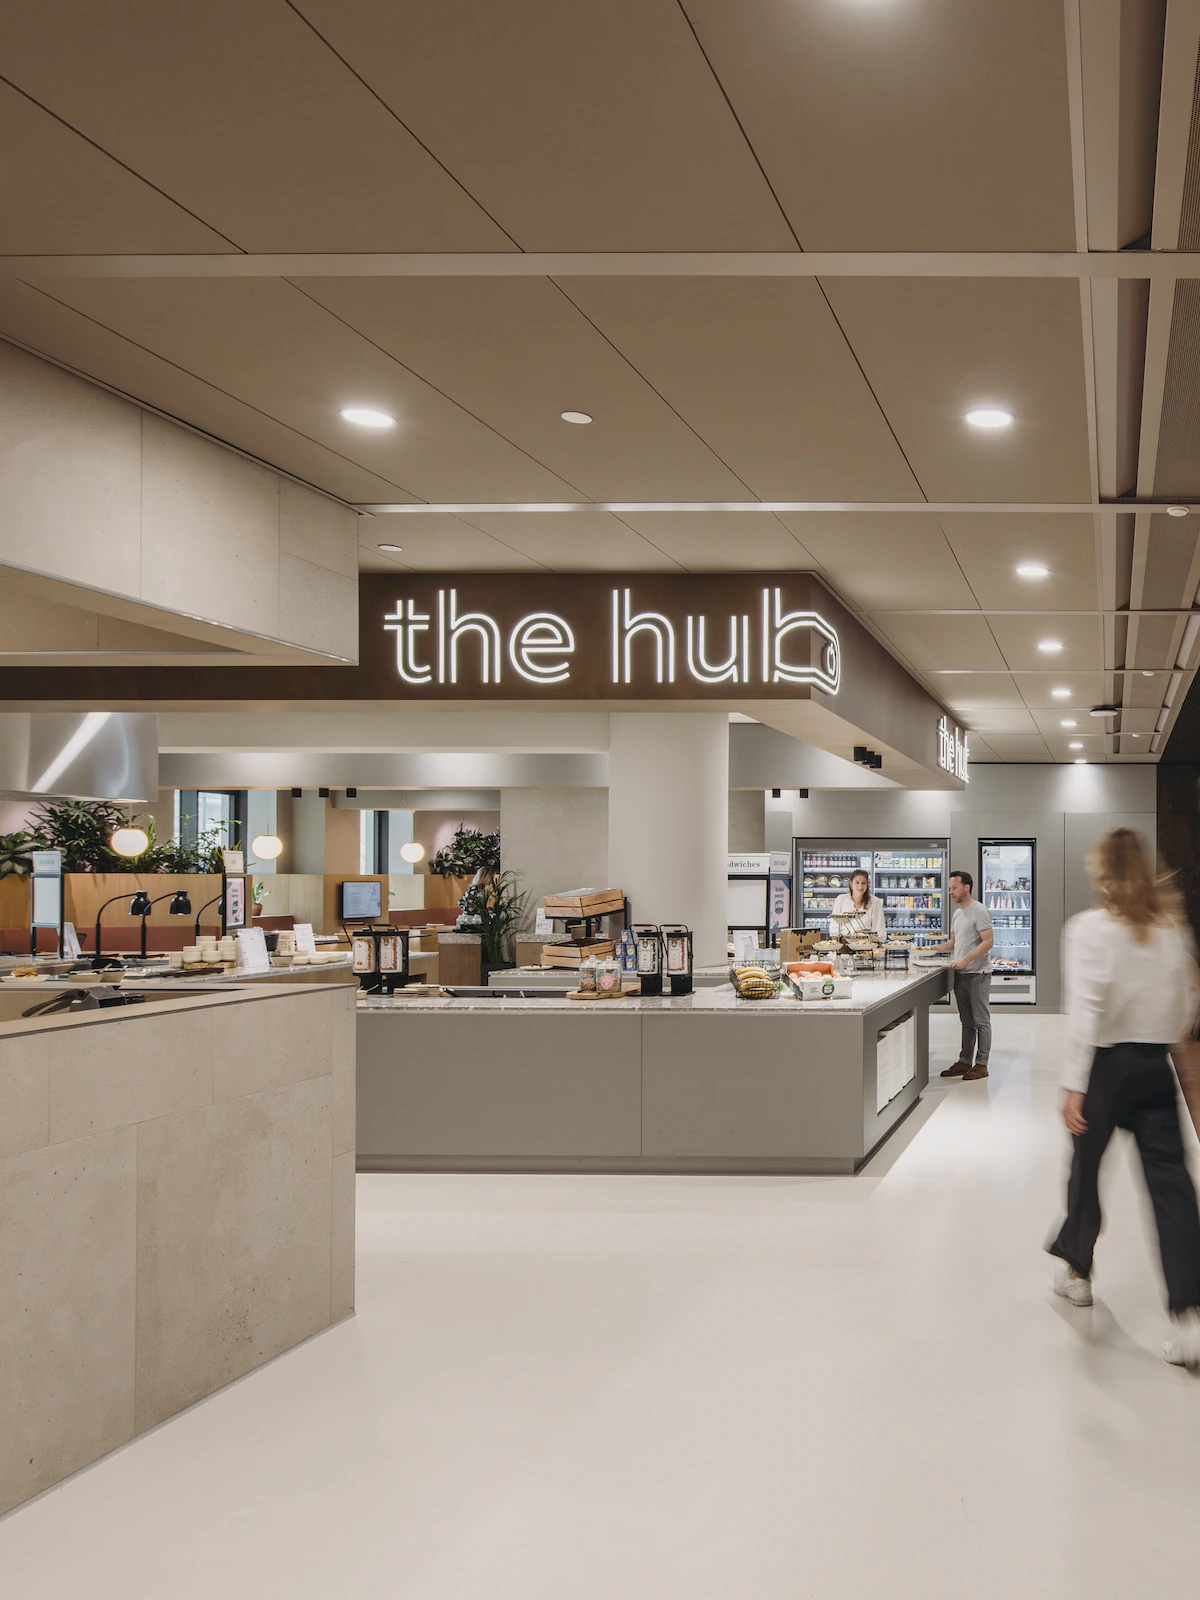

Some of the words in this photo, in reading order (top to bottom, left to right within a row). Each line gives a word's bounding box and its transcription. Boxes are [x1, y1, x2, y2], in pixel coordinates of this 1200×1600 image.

[384, 589, 575, 684] the
[612, 587, 841, 696] hub
[938, 715, 955, 774] the
